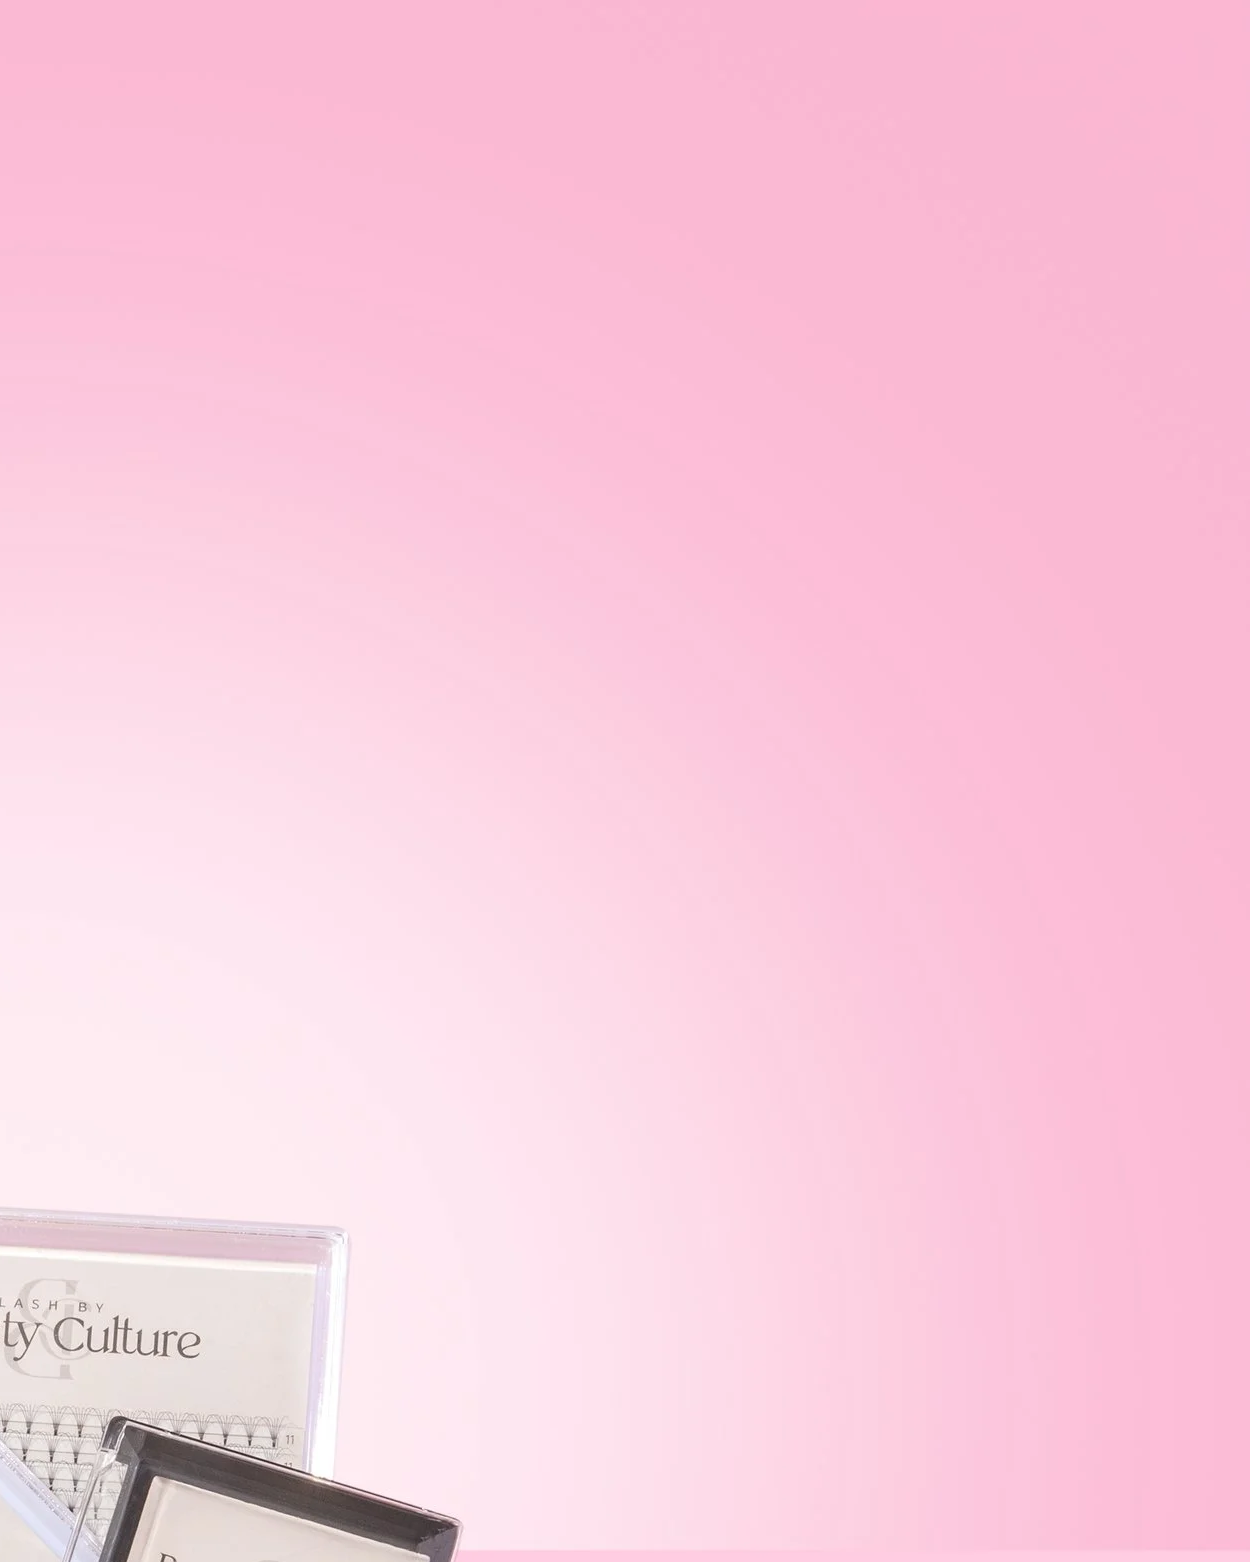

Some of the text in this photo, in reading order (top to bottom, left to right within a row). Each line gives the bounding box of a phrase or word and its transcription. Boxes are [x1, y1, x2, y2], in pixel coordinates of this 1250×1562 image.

[78, 1301, 105, 1313] BY
[53, 1314, 201, 1359] Culture
[285, 1434, 295, 1445] 11
